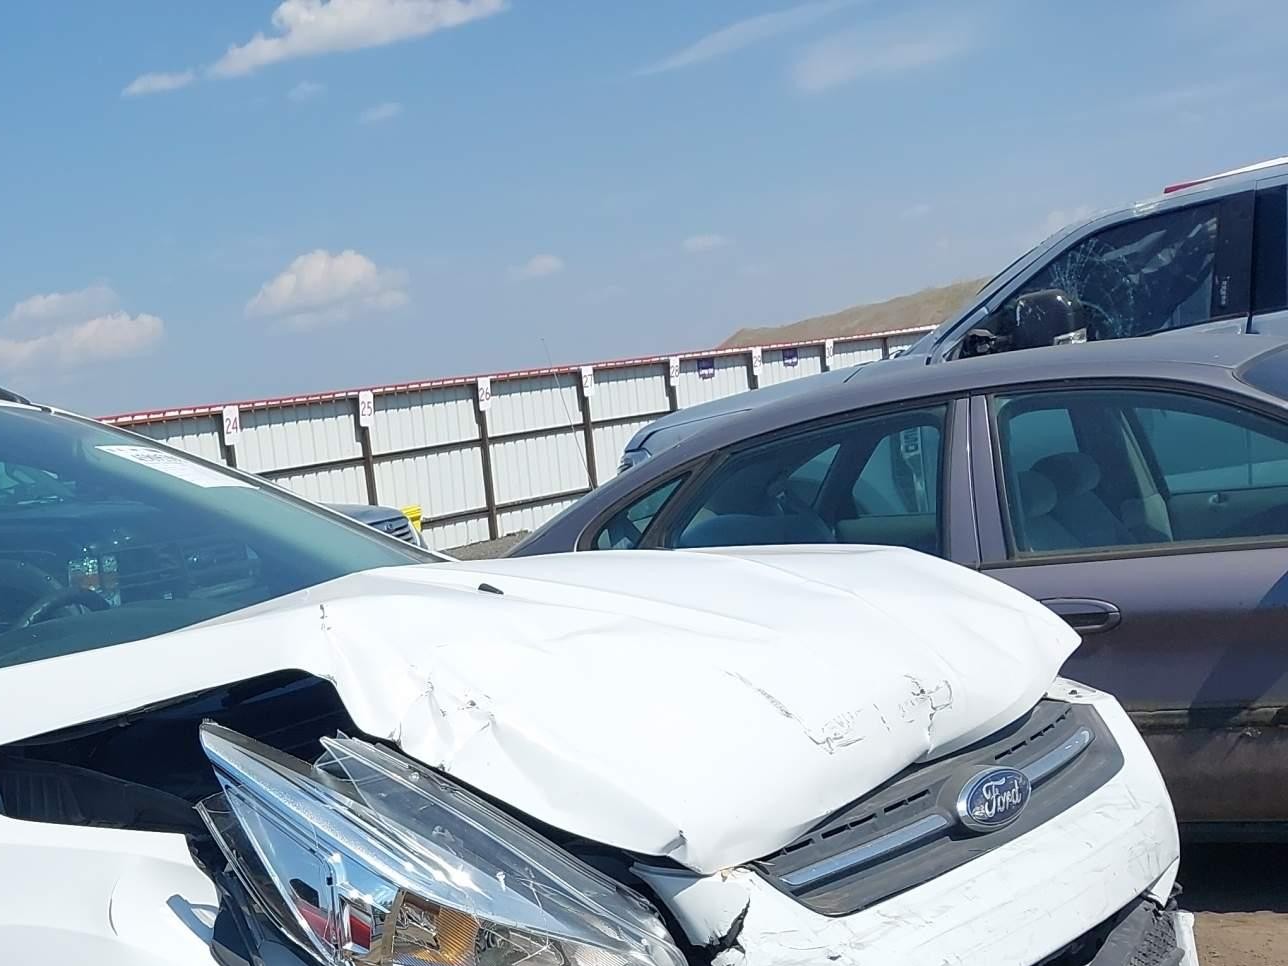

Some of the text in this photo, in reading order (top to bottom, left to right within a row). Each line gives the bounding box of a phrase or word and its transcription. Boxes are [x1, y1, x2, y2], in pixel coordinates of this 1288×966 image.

[753, 355, 762, 368] 29
[670, 364, 680, 378] 28
[583, 374, 593, 388] 27
[478, 387, 491, 402] 26
[360, 401, 373, 417] 25
[225, 416, 239, 435] 24
[982, 777, 1022, 818] Ford
